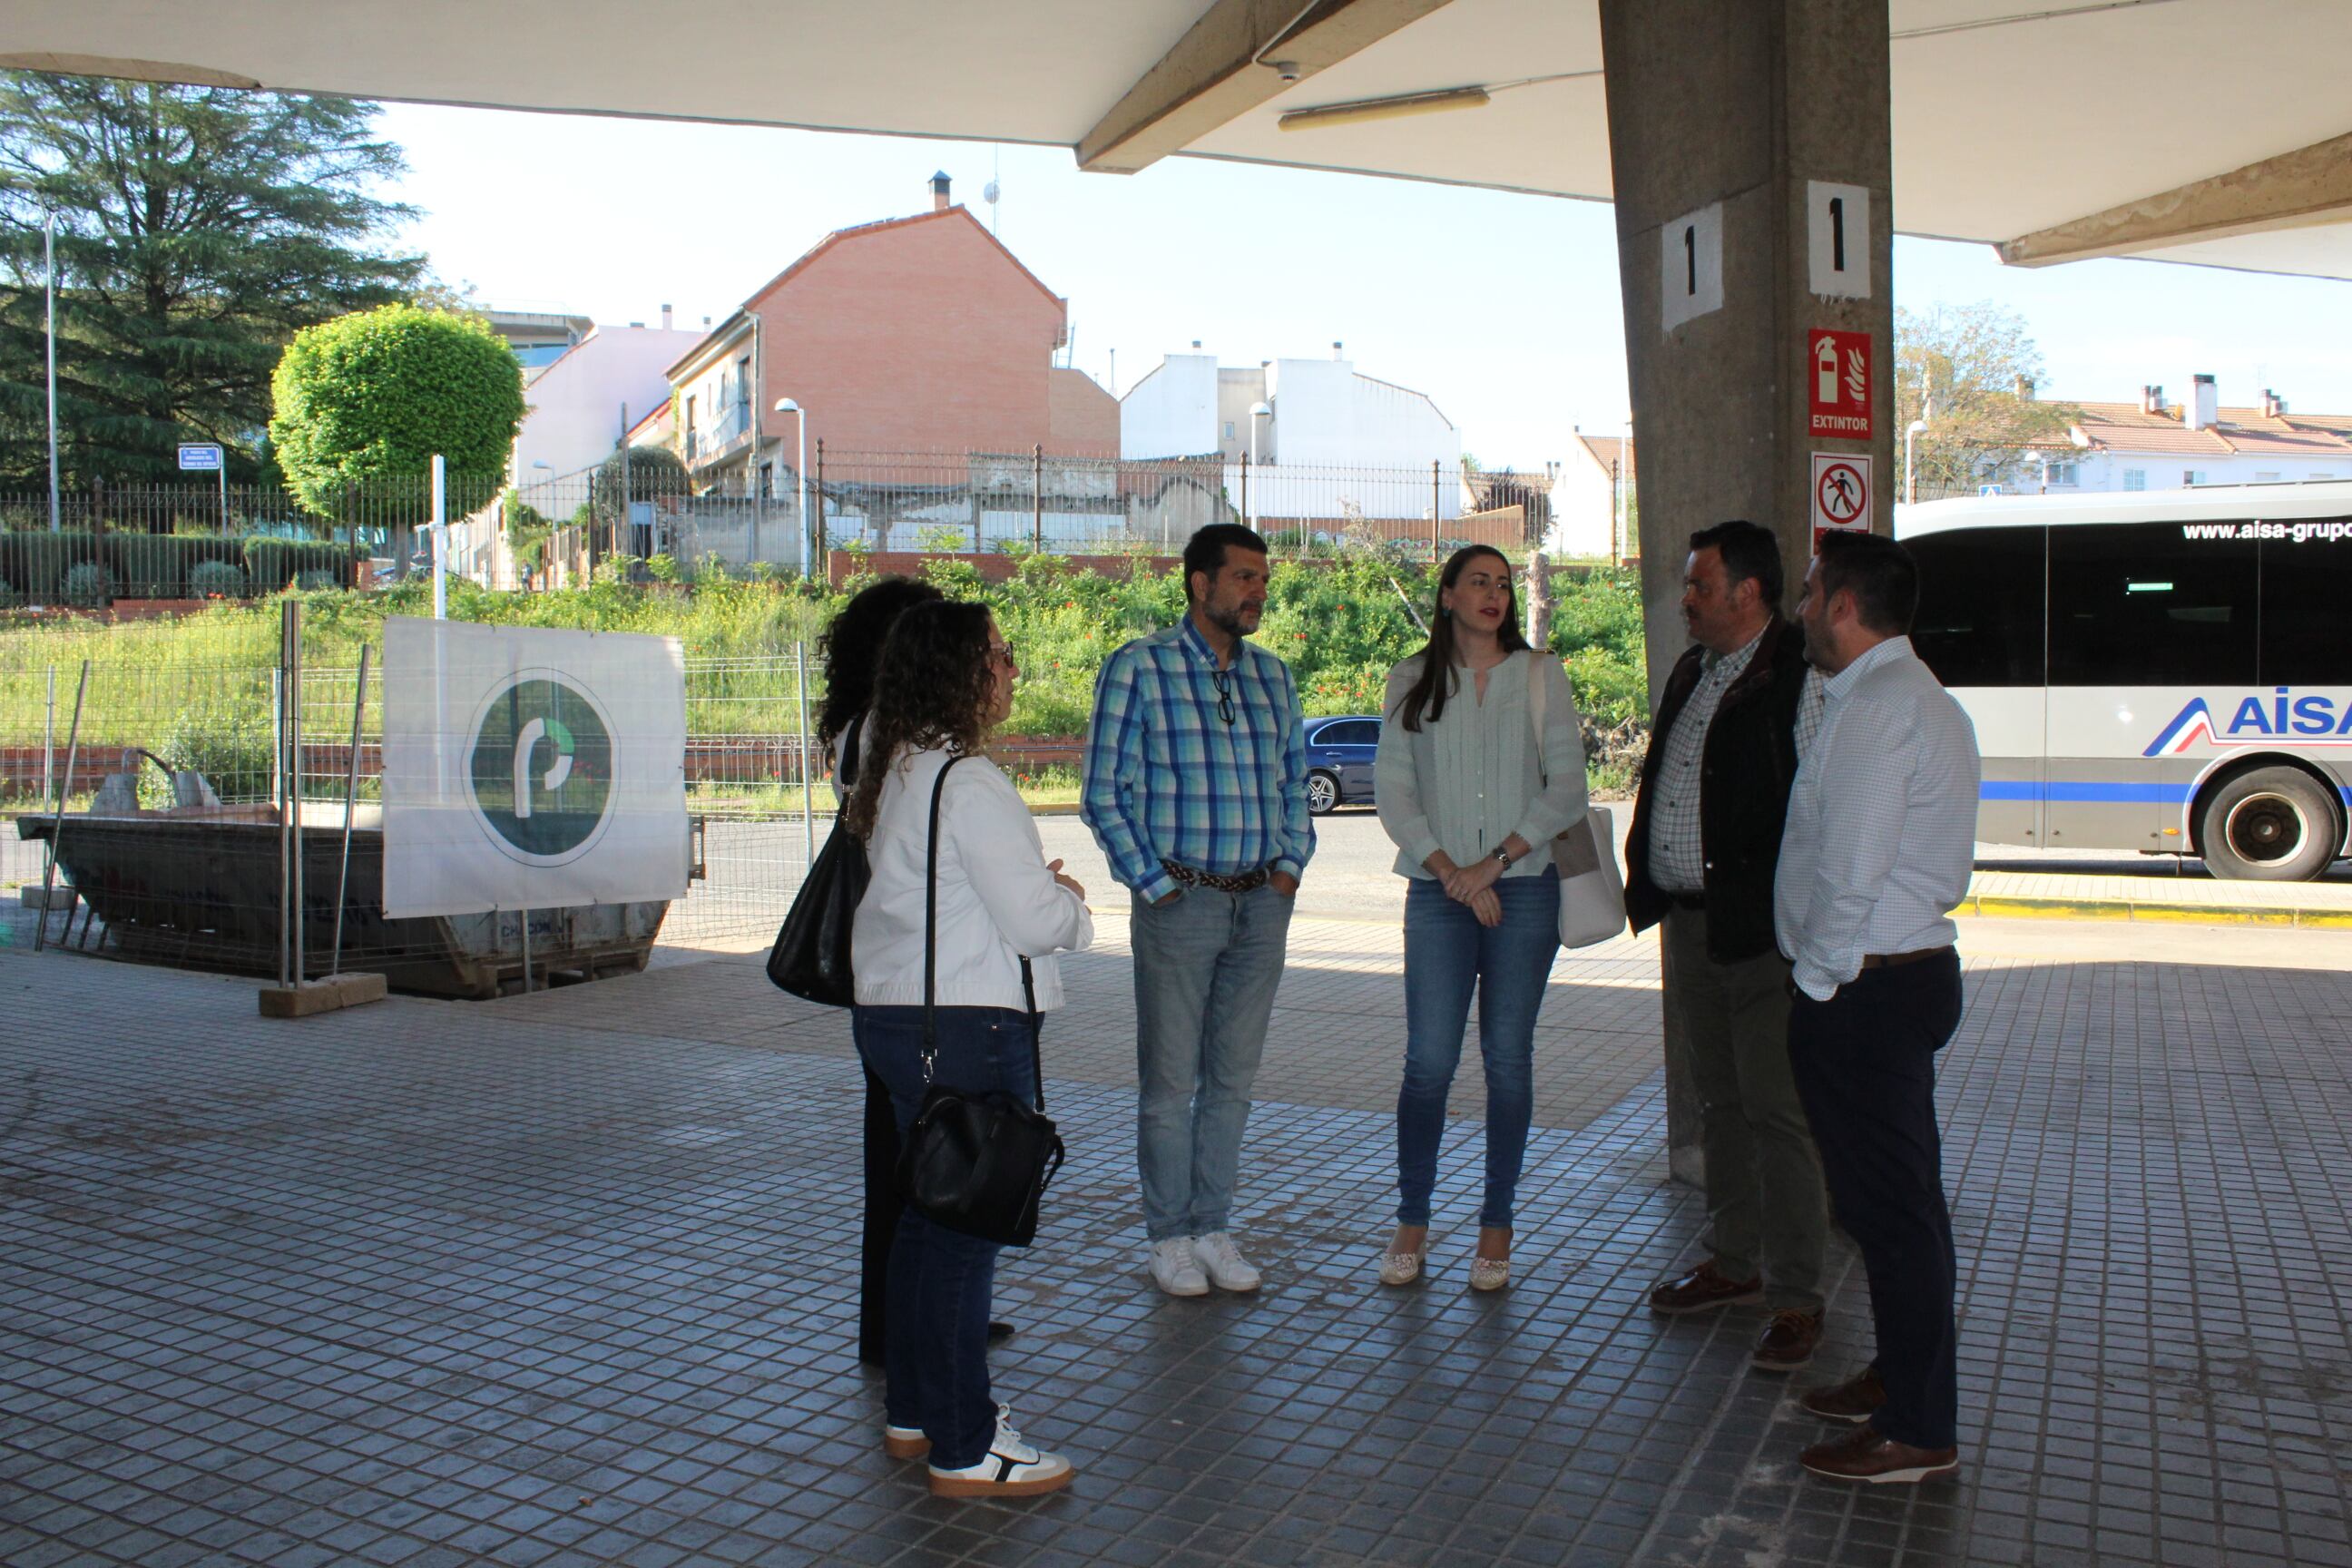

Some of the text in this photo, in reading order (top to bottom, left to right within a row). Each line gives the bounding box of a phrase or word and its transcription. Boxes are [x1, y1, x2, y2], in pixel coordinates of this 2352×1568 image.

[1685, 226, 1695, 296] 1
[1829, 198, 1844, 271] 1
[1813, 415, 1868, 431] EXTINTOR
